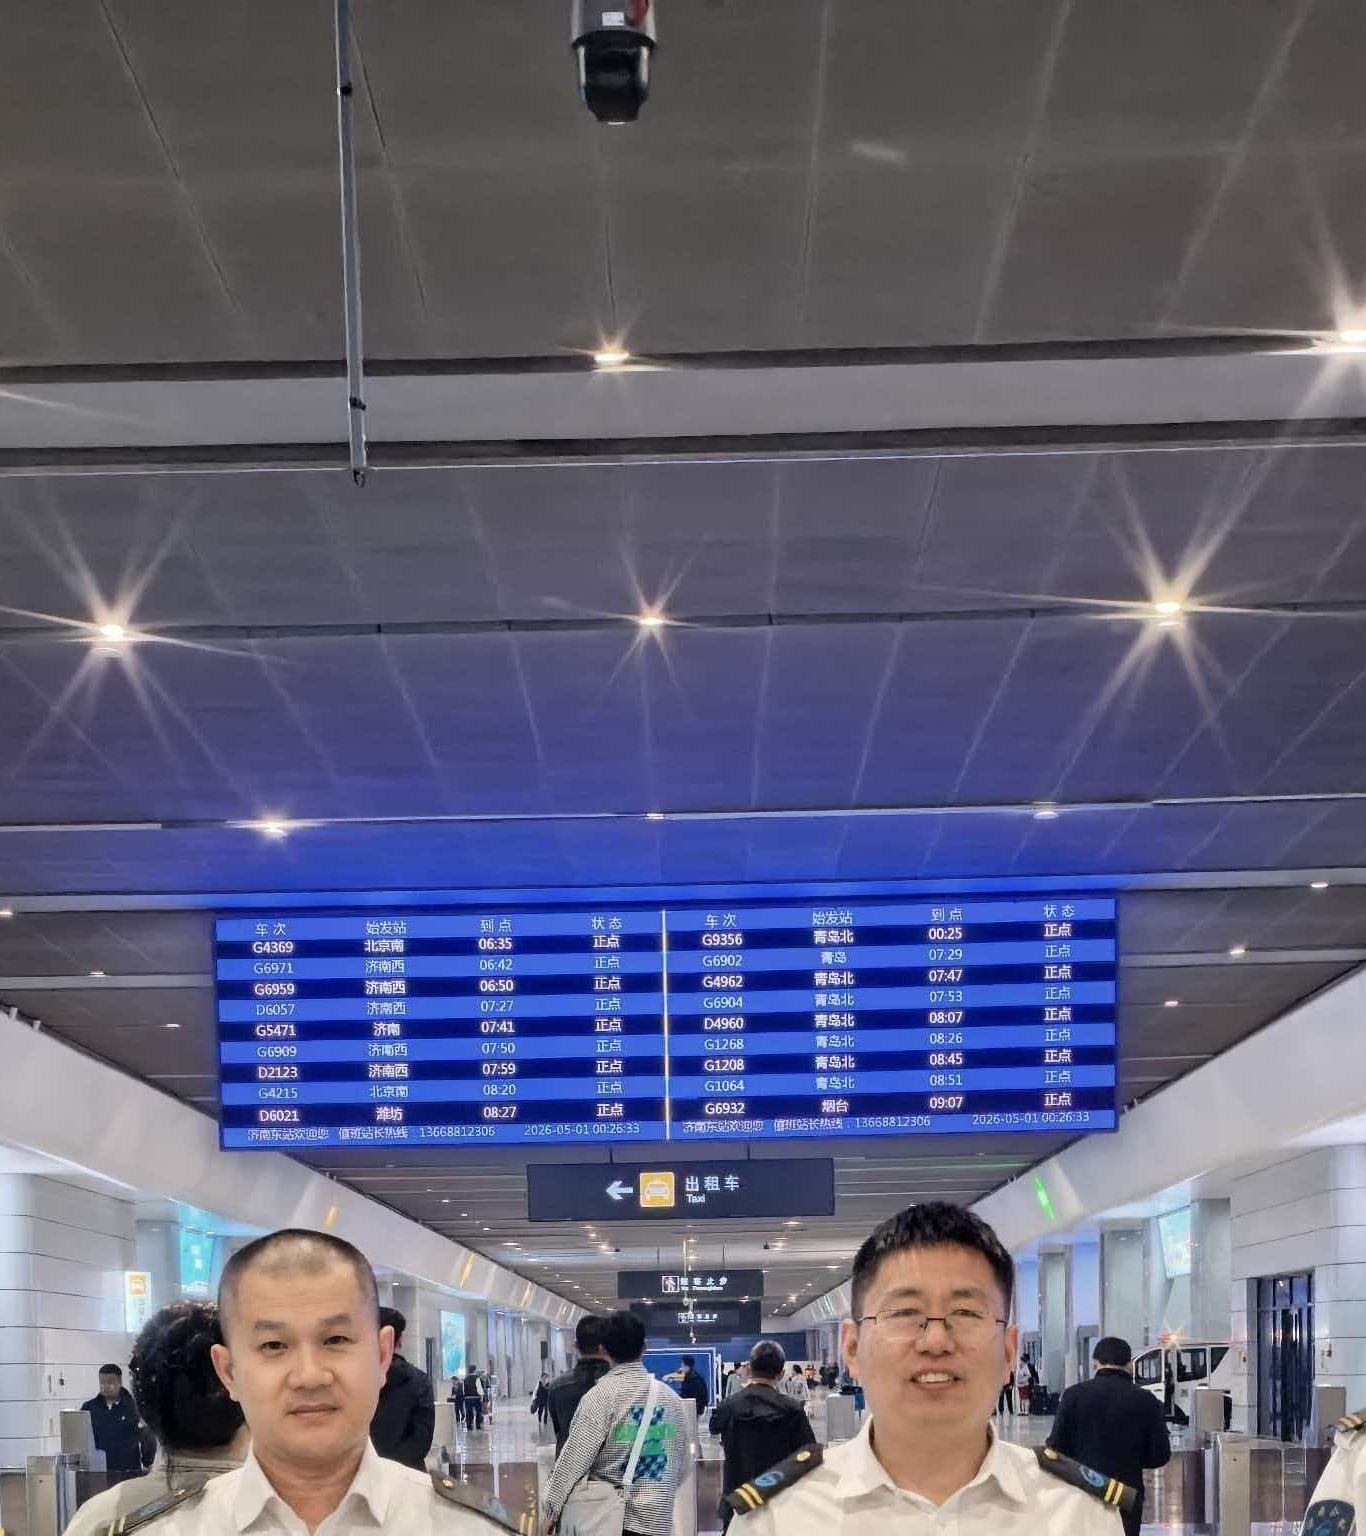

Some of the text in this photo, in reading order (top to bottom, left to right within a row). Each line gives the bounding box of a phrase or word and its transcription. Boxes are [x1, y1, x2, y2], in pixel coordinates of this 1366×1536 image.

[366, 920, 407, 936] 始发站
[812, 911, 853, 926] 始发站
[365, 939, 404, 953] 北京南
[479, 937, 512, 951] 06:35
[593, 935, 619, 949] 正点
[703, 924, 1071, 946] G9356 青岛北 00:25 正点
[253, 956, 620, 974] G6971 济南西 06:42 正点
[703, 945, 1071, 967] G6902 青岛 07:29 正点
[255, 977, 621, 996] G6959 济南西 06:50 正点
[703, 966, 1071, 988] G4962 青岛北 07:47 正点
[256, 997, 621, 1016] D6057 济南西 07:27 正点
[704, 987, 1071, 1009] G6904 青岛北 07:53 正点
[257, 1018, 622, 1037] G5471 济南 07:41 正点
[705, 1008, 1071, 1030] D4960 青岛北 08:07 正点
[257, 1039, 621, 1058] G6909 济南西 07:50 正点
[705, 1028, 1071, 1051] G1268 青岛北 08:26 正点
[258, 1060, 623, 1079] D2123 济南西 07:59 正点
[705, 1049, 1071, 1072] G1208 青岛北 08:45 正点
[259, 1081, 622, 1100] G4215 北京南 08:20 正点
[705, 1070, 1071, 1093] G1064 青岛北 08:51 正点
[259, 1109, 299, 1123] D6021
[484, 1105, 517, 1118] 08:27
[597, 1103, 623, 1117] 正点
[705, 1093, 1071, 1116] G6932 烟台 09:07 正点
[685, 1175, 740, 1192] 出租车
[686, 1194, 706, 1204] Taxi
